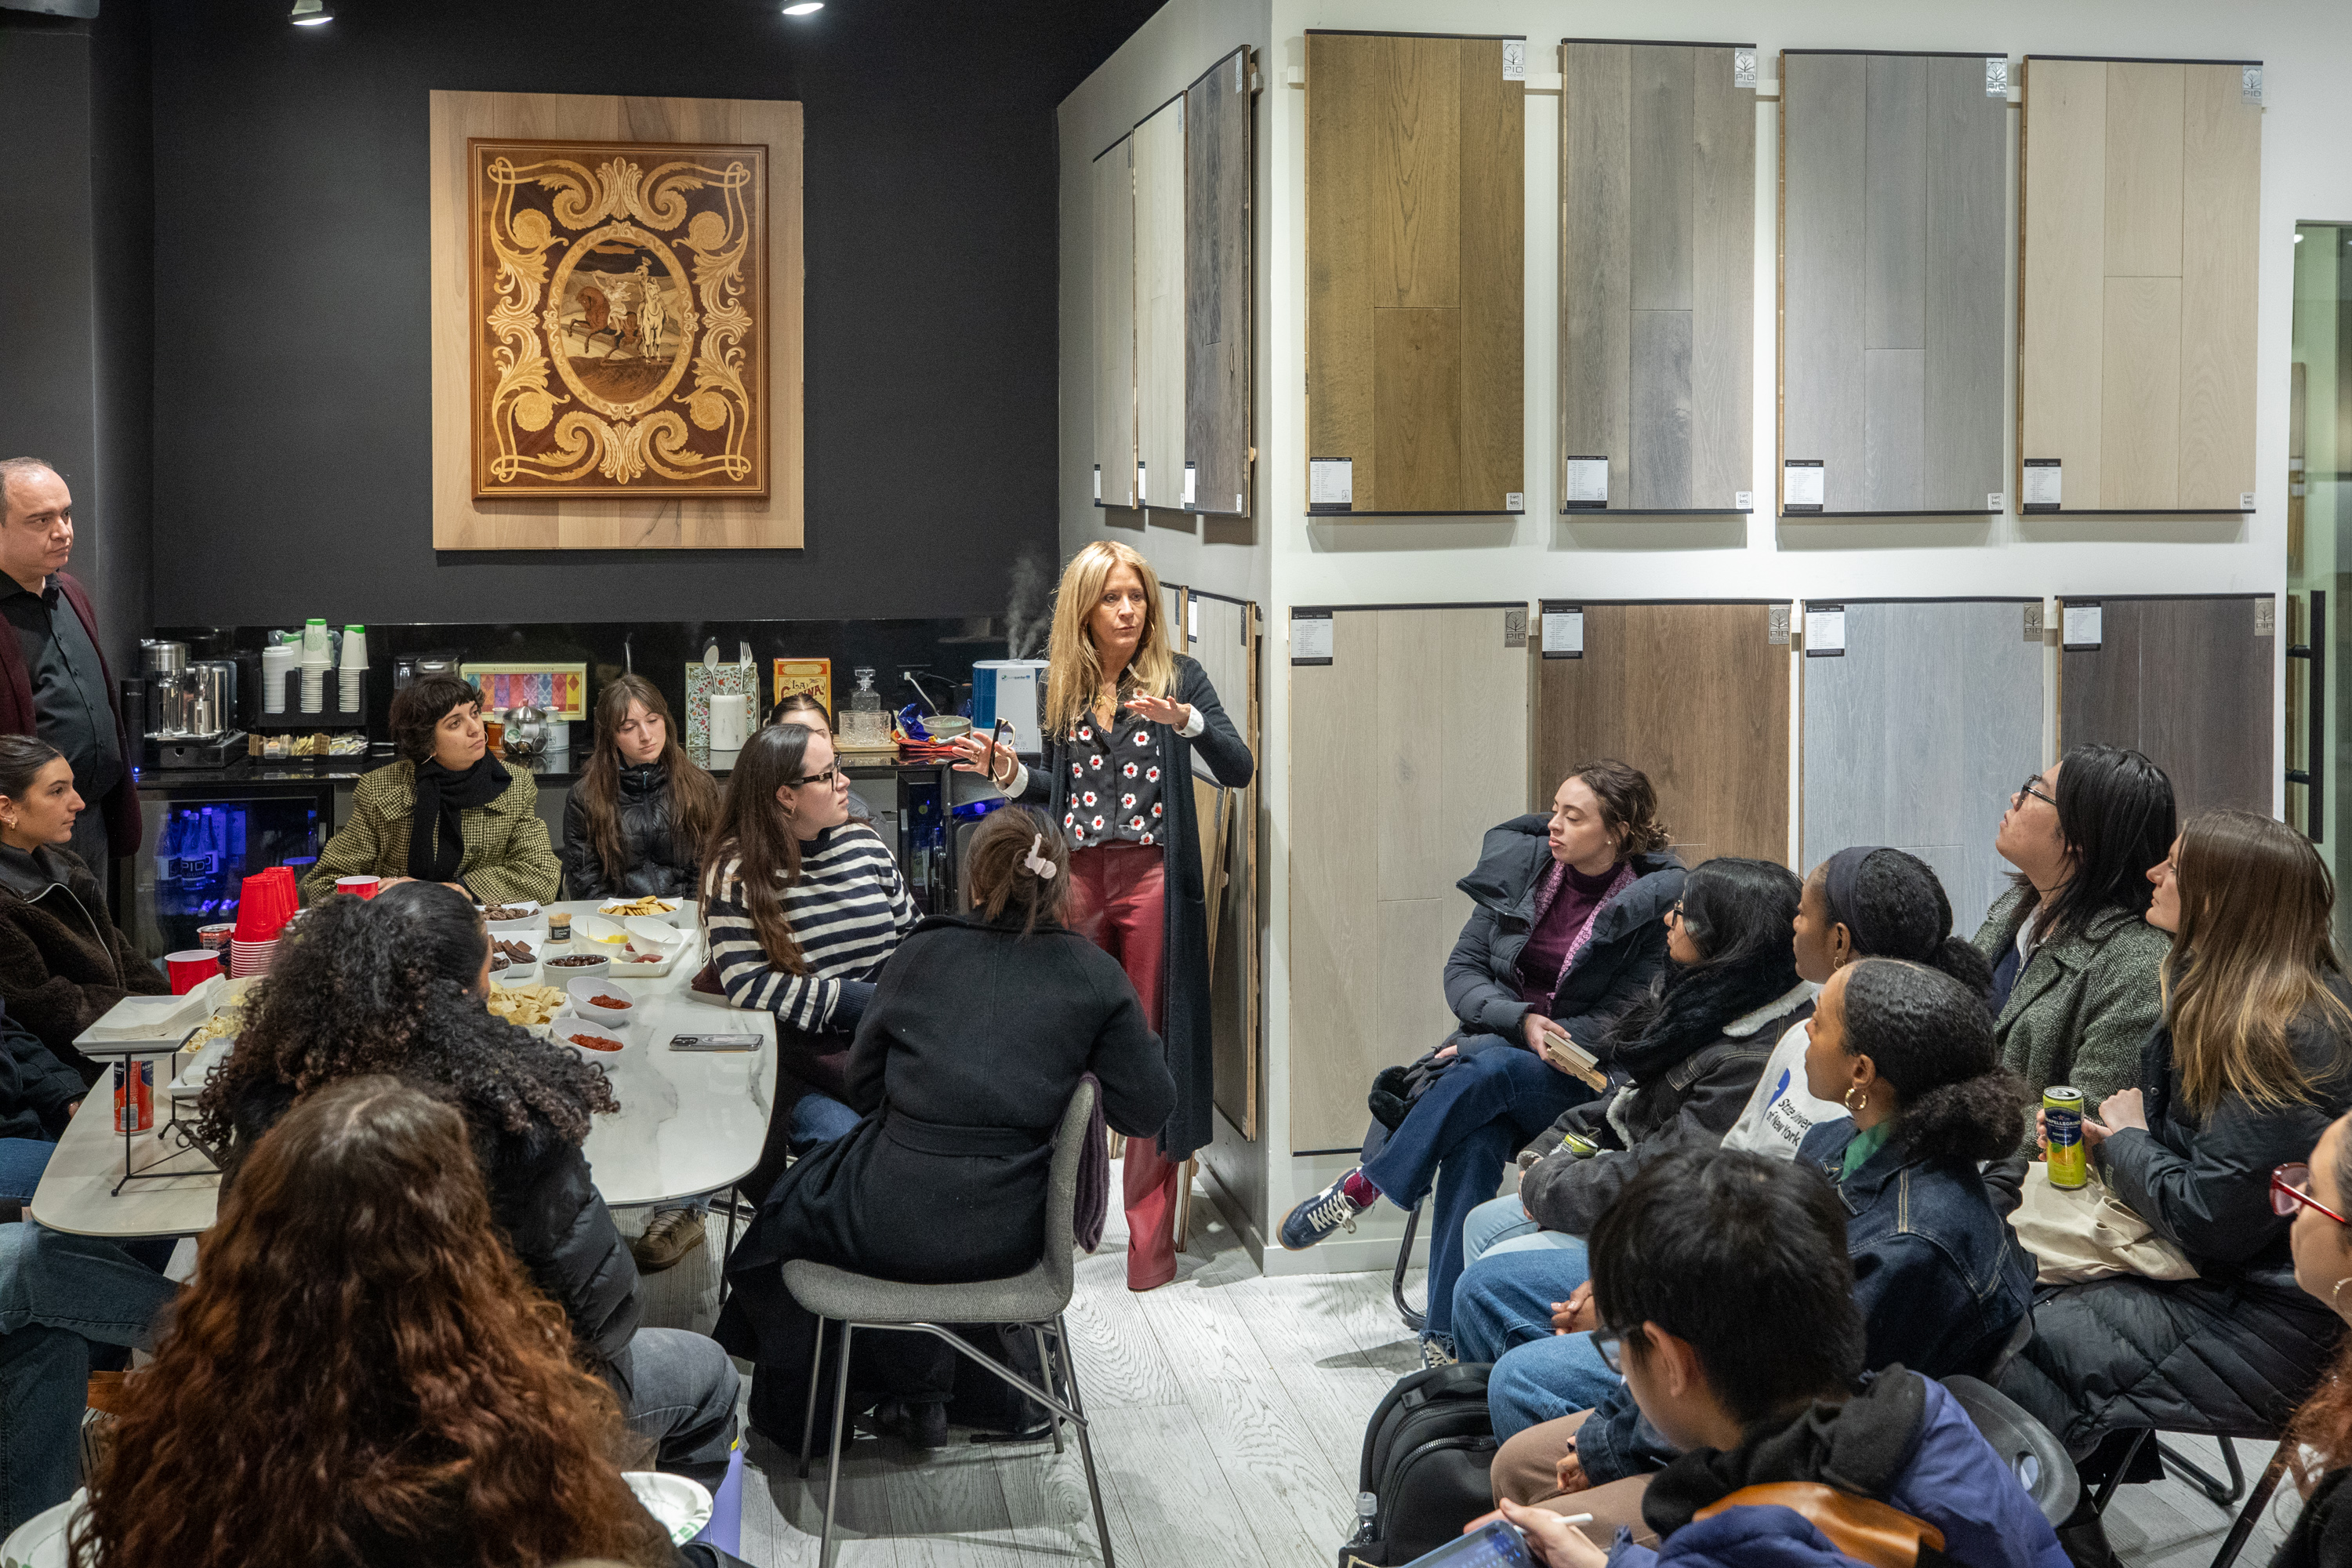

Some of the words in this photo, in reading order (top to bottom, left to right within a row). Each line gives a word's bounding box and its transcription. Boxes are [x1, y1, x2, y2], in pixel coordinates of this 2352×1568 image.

[792, 680, 805, 689] LA
[180, 861, 205, 872] PID
[1778, 1098, 1795, 1116] State
[1772, 1114, 1785, 1132] New
[1781, 1124, 1801, 1146] York
